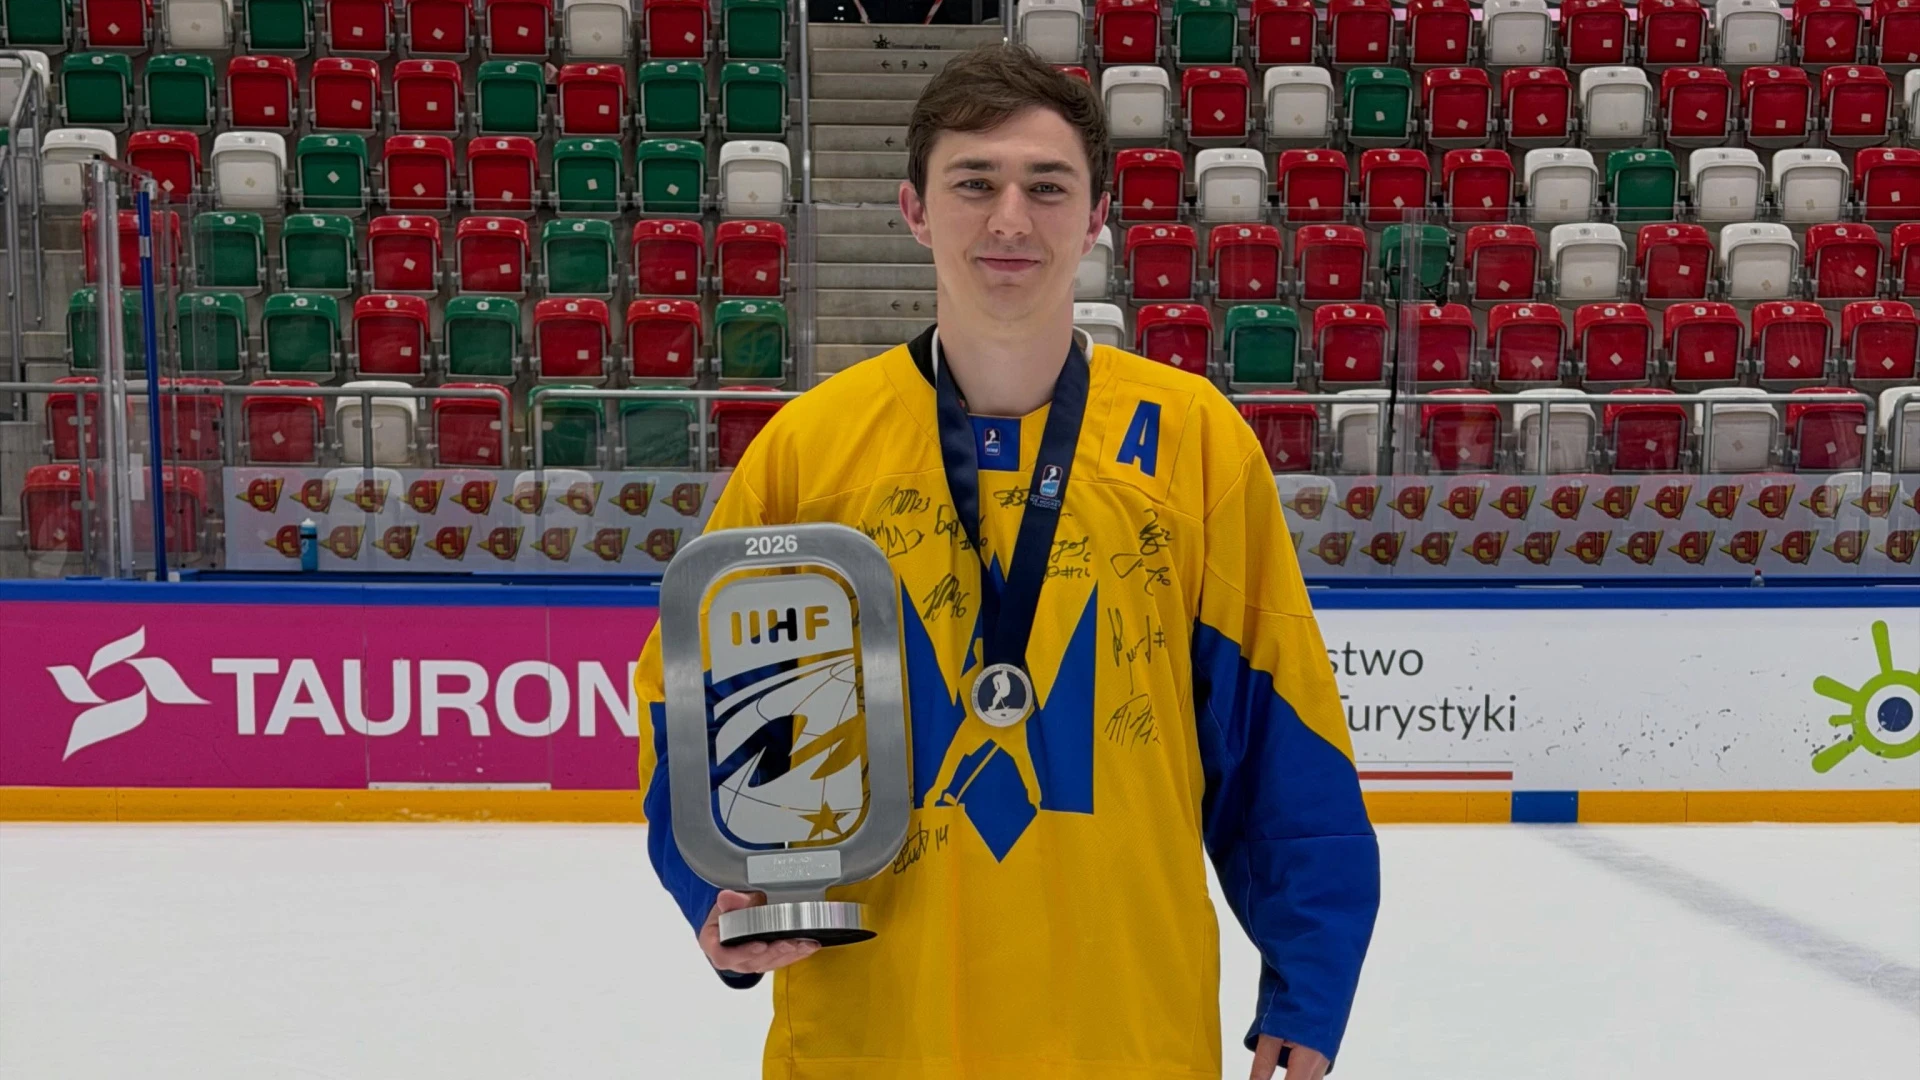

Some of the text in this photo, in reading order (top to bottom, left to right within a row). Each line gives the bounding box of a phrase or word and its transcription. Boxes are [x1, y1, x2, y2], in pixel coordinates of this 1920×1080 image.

[1116, 400, 1161, 477] A
[745, 534, 798, 556] 2026
[731, 605, 830, 646] IIHF
[212, 658, 638, 737] TAURON
[935, 824, 949, 852] 14
